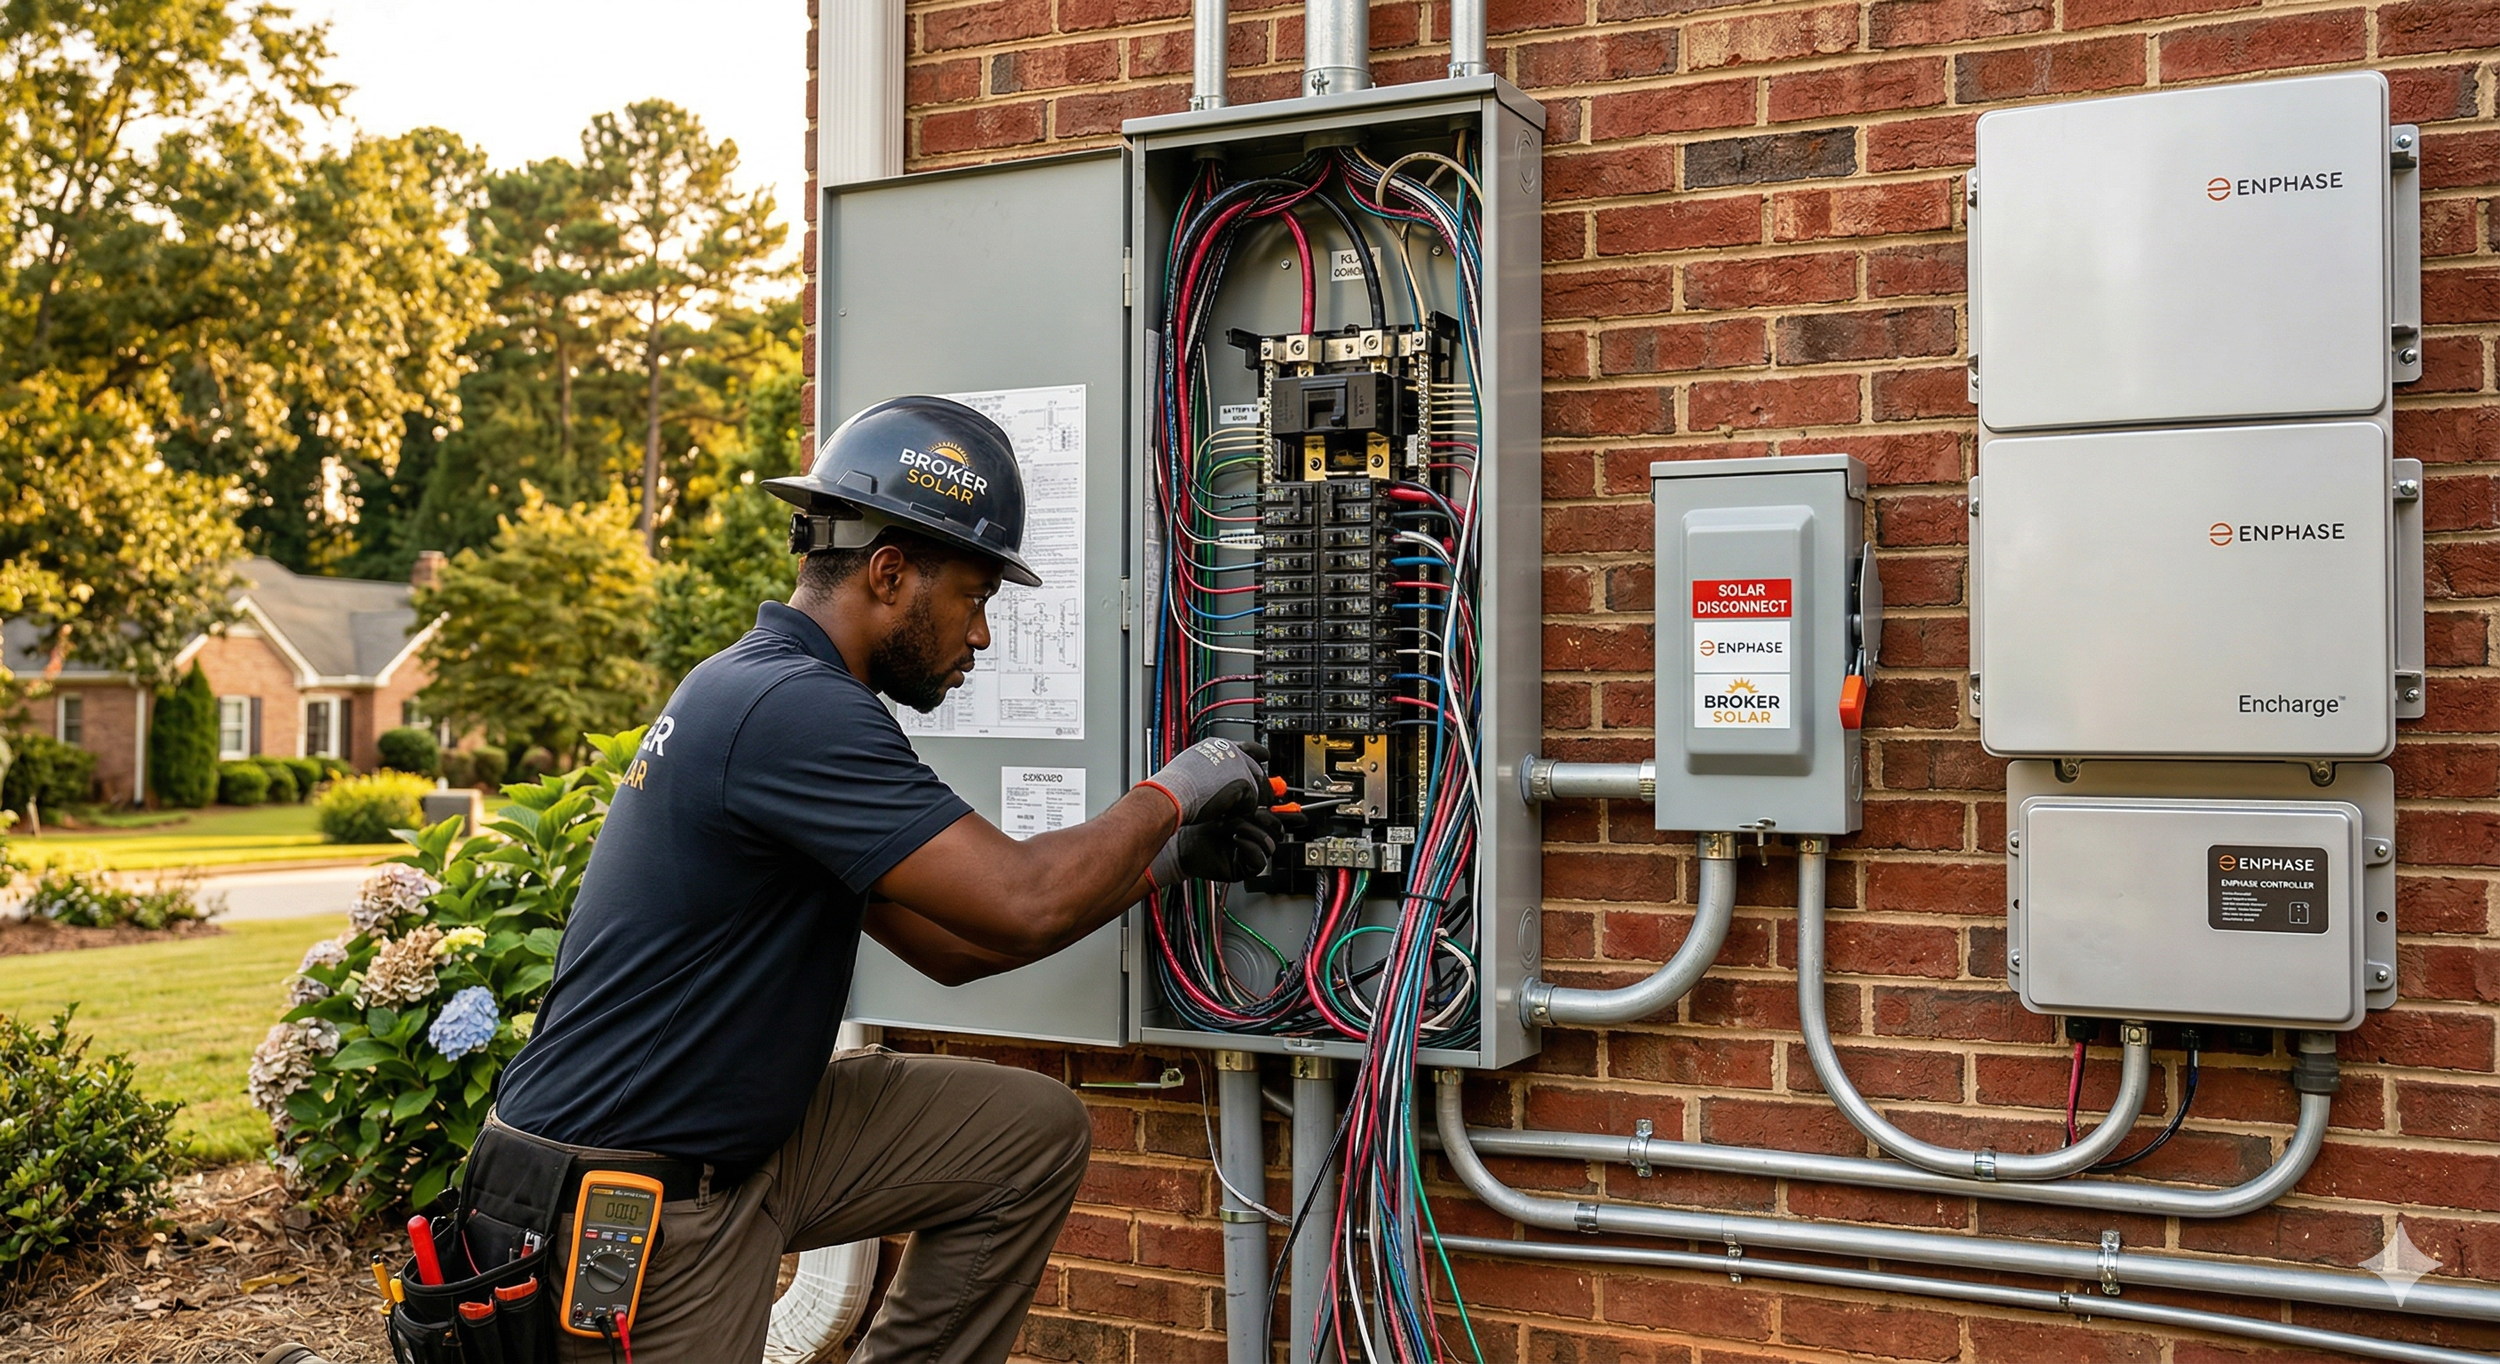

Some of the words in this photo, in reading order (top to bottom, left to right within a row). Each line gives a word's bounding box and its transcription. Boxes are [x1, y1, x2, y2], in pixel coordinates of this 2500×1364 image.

[2237, 172, 2343, 196] ENPHASE
[899, 448, 988, 496] BROKER
[906, 468, 974, 506] SOLAR
[2239, 523, 2346, 542] ENPHASE
[1718, 583, 1766, 597] SOLAR
[1697, 599, 1788, 614] DISCONNECT
[1717, 641, 1783, 654] ENPHASE
[1704, 695, 1780, 709] BROKER
[1713, 710, 1771, 723] SOLAR
[2239, 857, 2315, 872] ENPHASE
[2260, 880, 2315, 890] CONTROLLER
